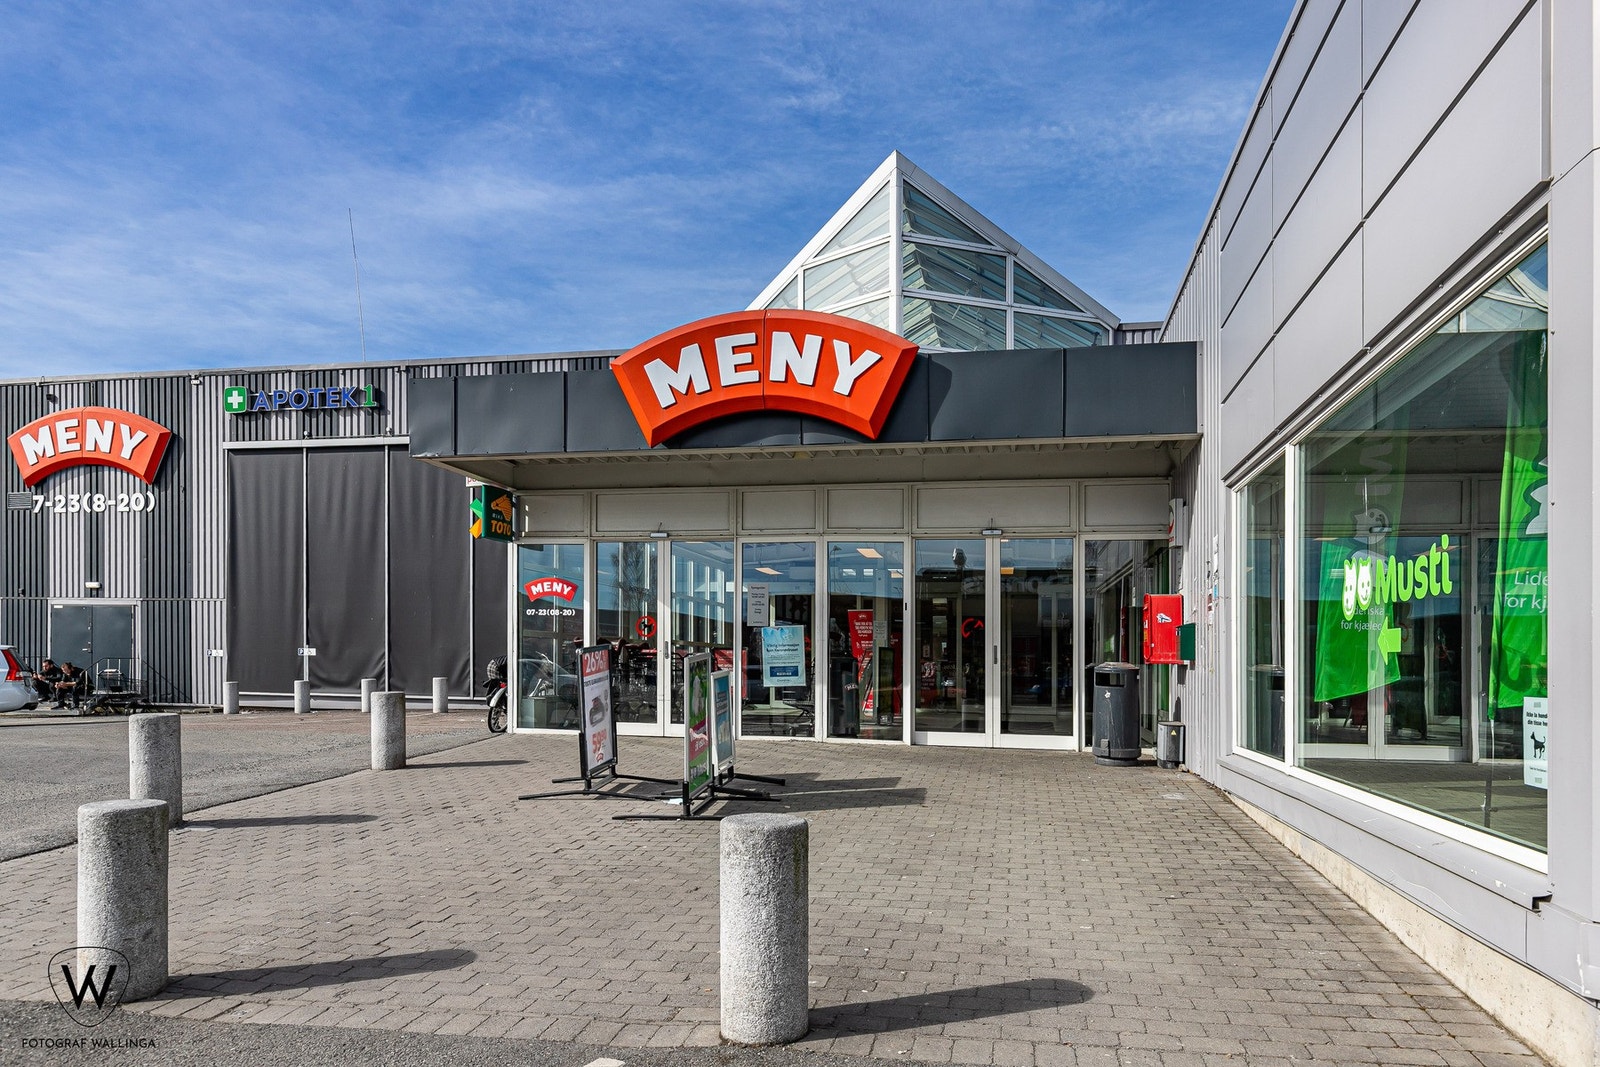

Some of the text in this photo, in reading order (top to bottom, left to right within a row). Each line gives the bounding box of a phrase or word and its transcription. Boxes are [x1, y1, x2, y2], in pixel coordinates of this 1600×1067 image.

[643, 331, 882, 409] MENY
[252, 384, 377, 411] APOTEK 1
[19, 418, 148, 467] MENY
[491, 520, 512, 536] TOTO
[1375, 533, 1453, 605] Musti
[530, 581, 573, 596] MENY
[1503, 592, 1527, 608] for
[526, 608, 576, 616] 07-23(08-20)
[1340, 619, 1353, 630] for
